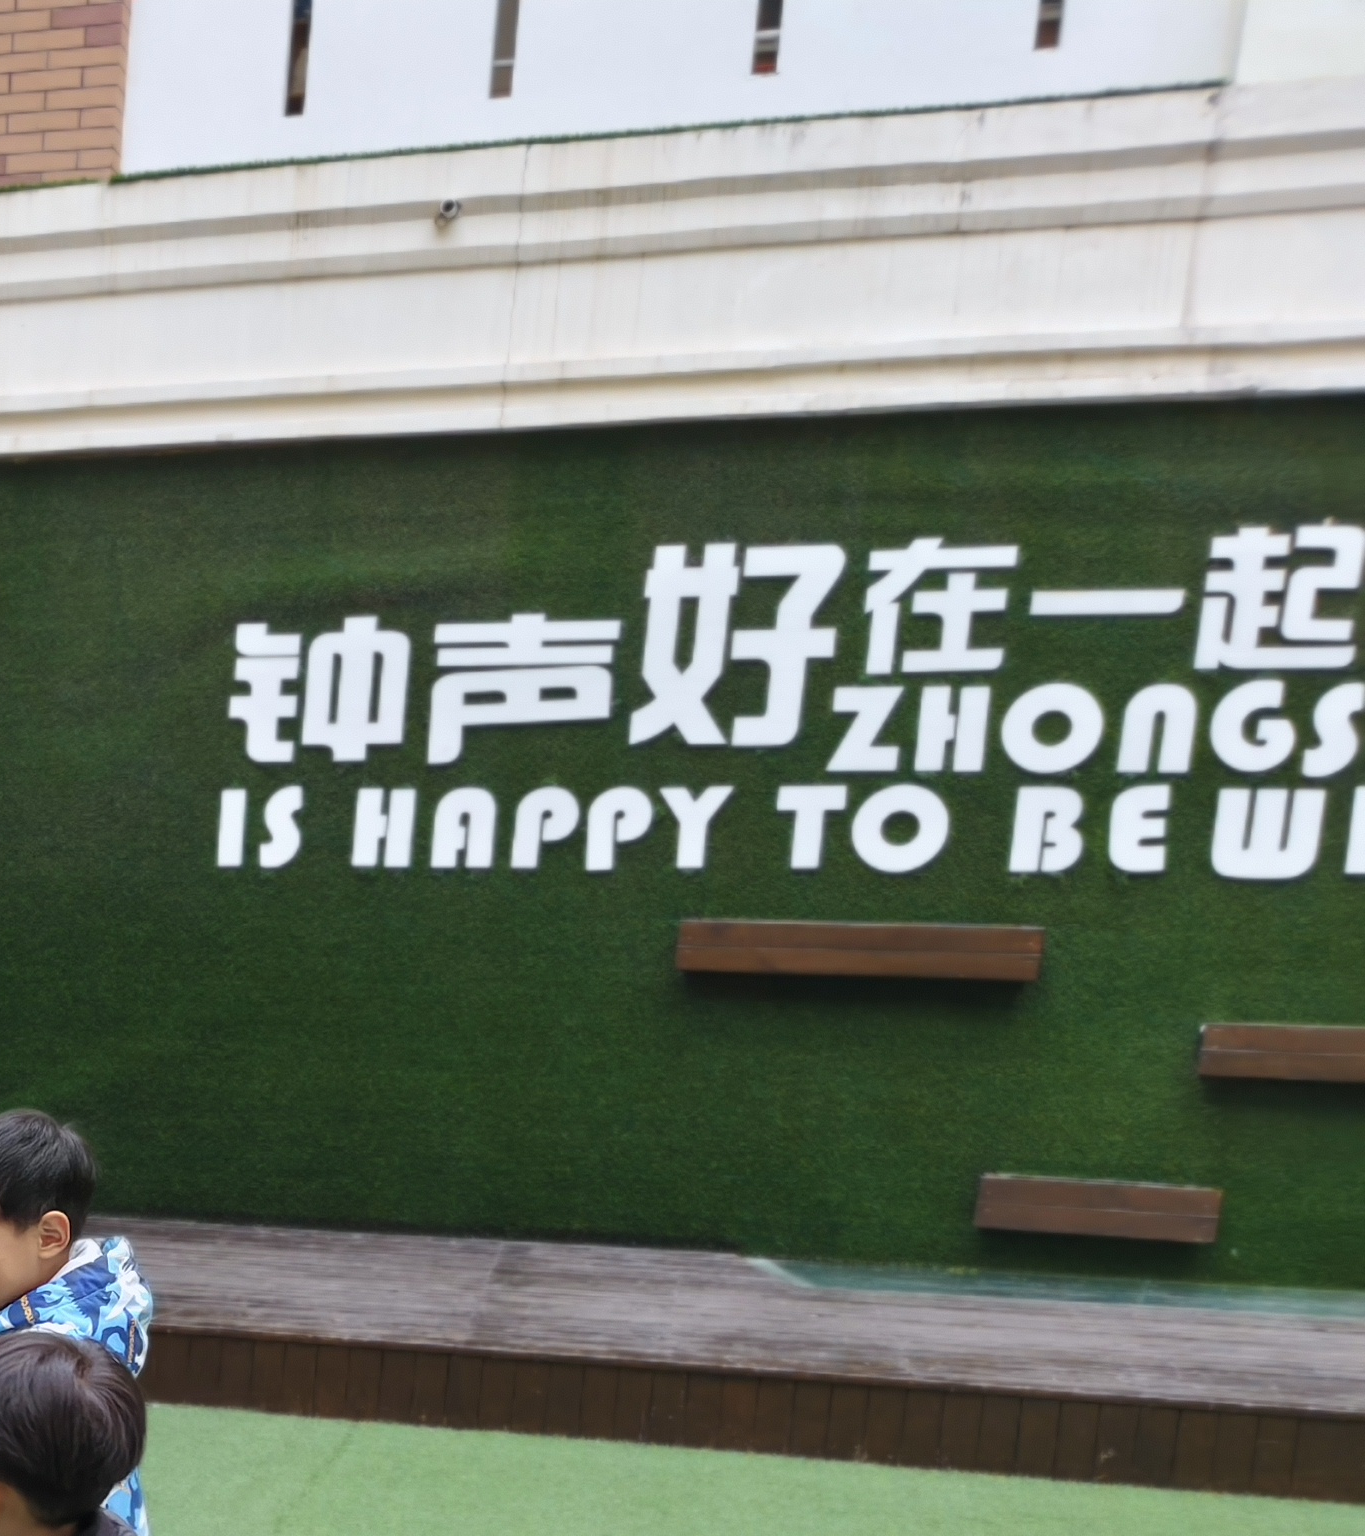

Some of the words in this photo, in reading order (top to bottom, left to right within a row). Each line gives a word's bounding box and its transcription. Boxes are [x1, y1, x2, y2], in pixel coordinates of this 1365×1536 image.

[228, 524, 1365, 765] 钟声好在一起
[217, 785, 304, 868] IS
[351, 785, 734, 872] HAPPY
[777, 784, 950, 874] TO
[1008, 784, 1170, 874] BE
